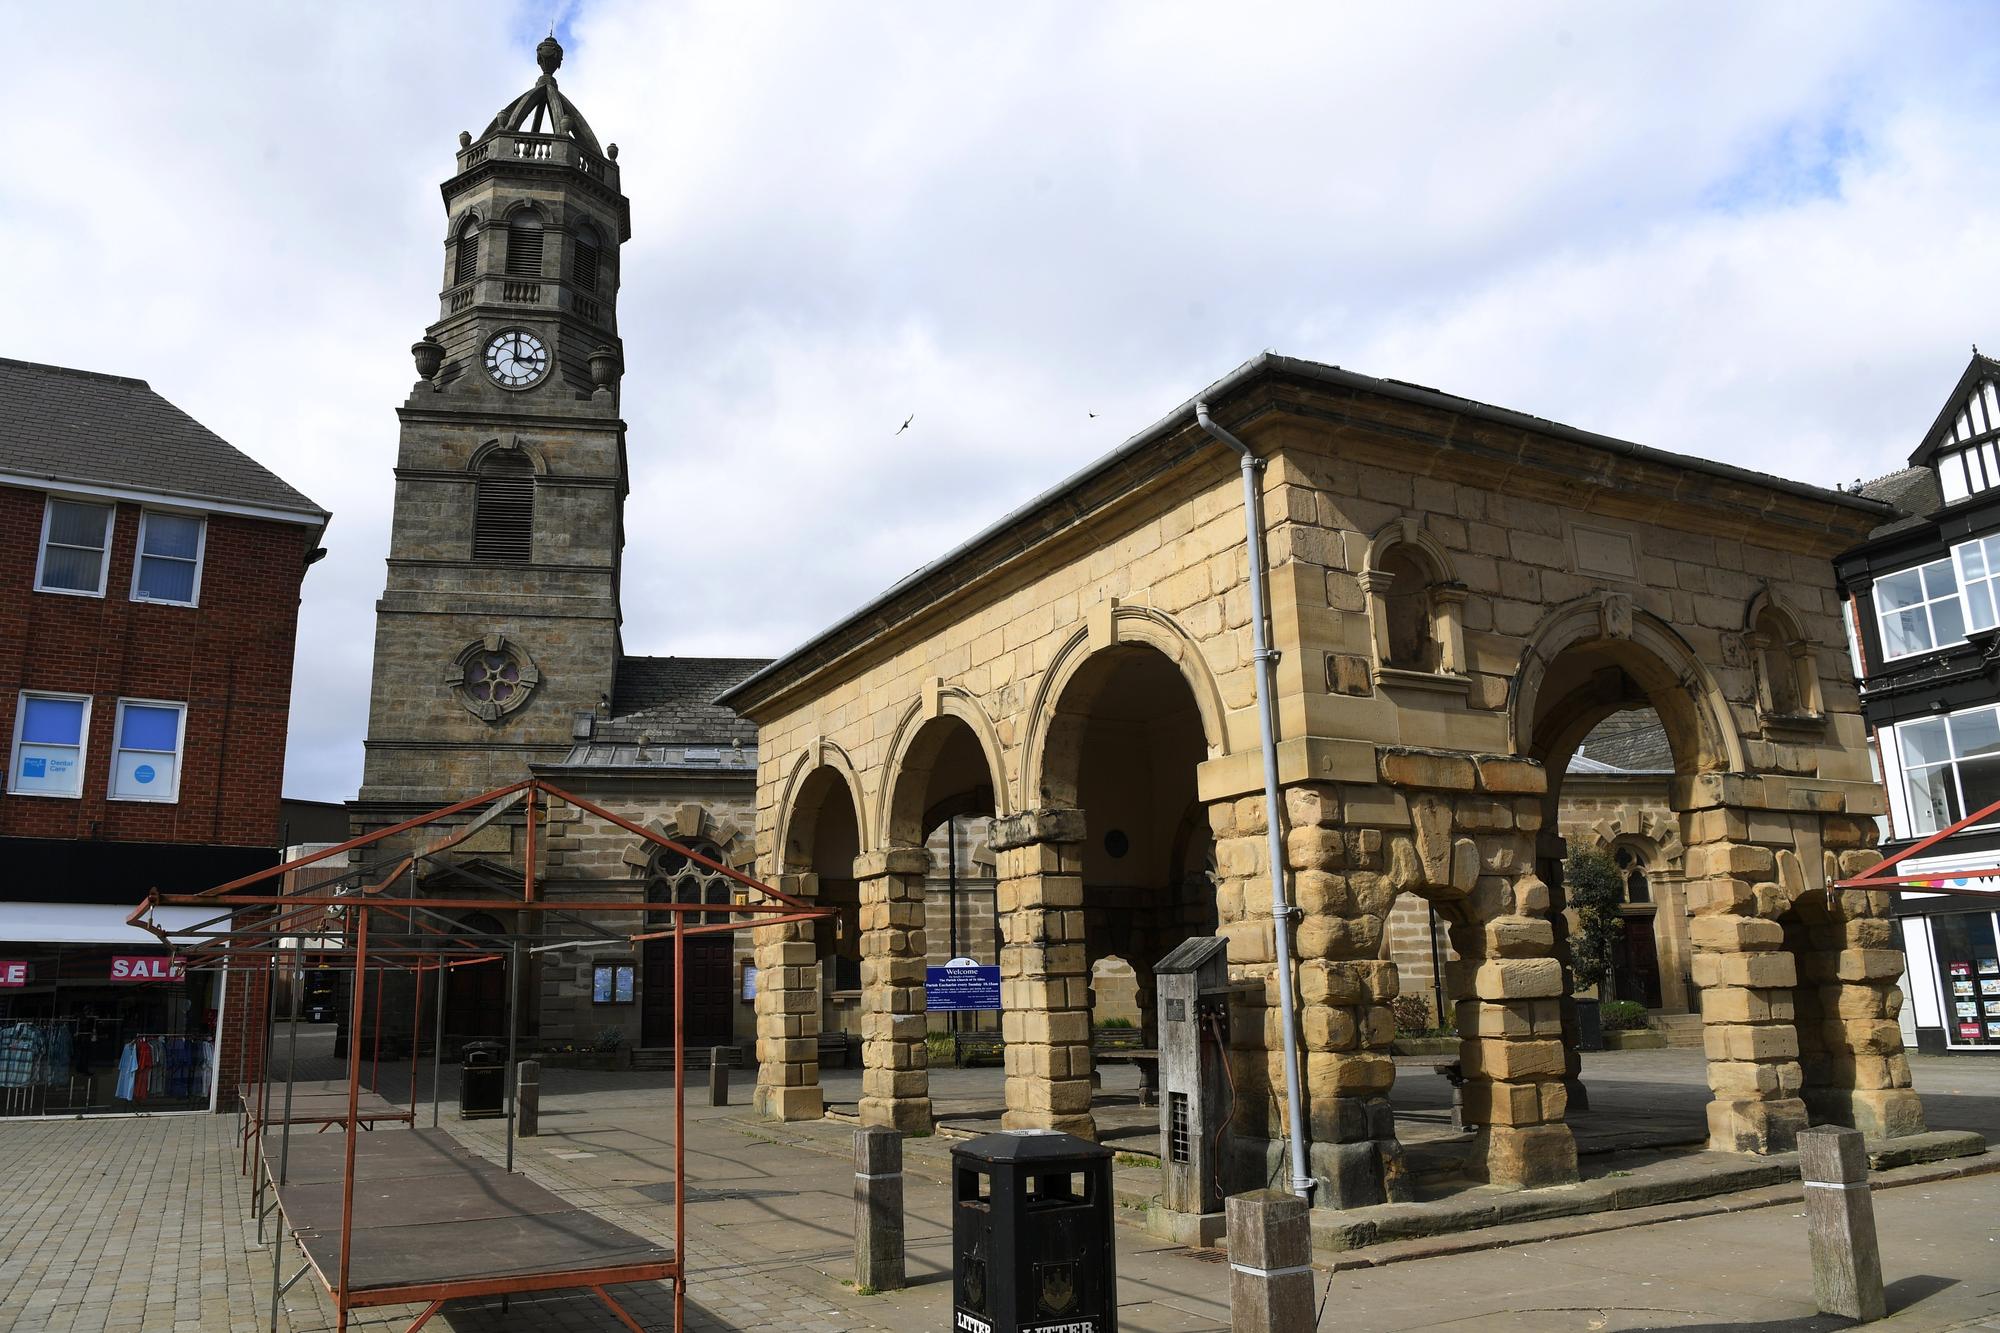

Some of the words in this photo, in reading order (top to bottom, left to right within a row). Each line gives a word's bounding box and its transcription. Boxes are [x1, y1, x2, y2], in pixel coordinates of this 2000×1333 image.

[50, 759, 73, 767] Dental
[0, 965, 25, 983] E
[957, 1312, 991, 1333] LITTER
[1022, 1321, 1094, 1333] TER
